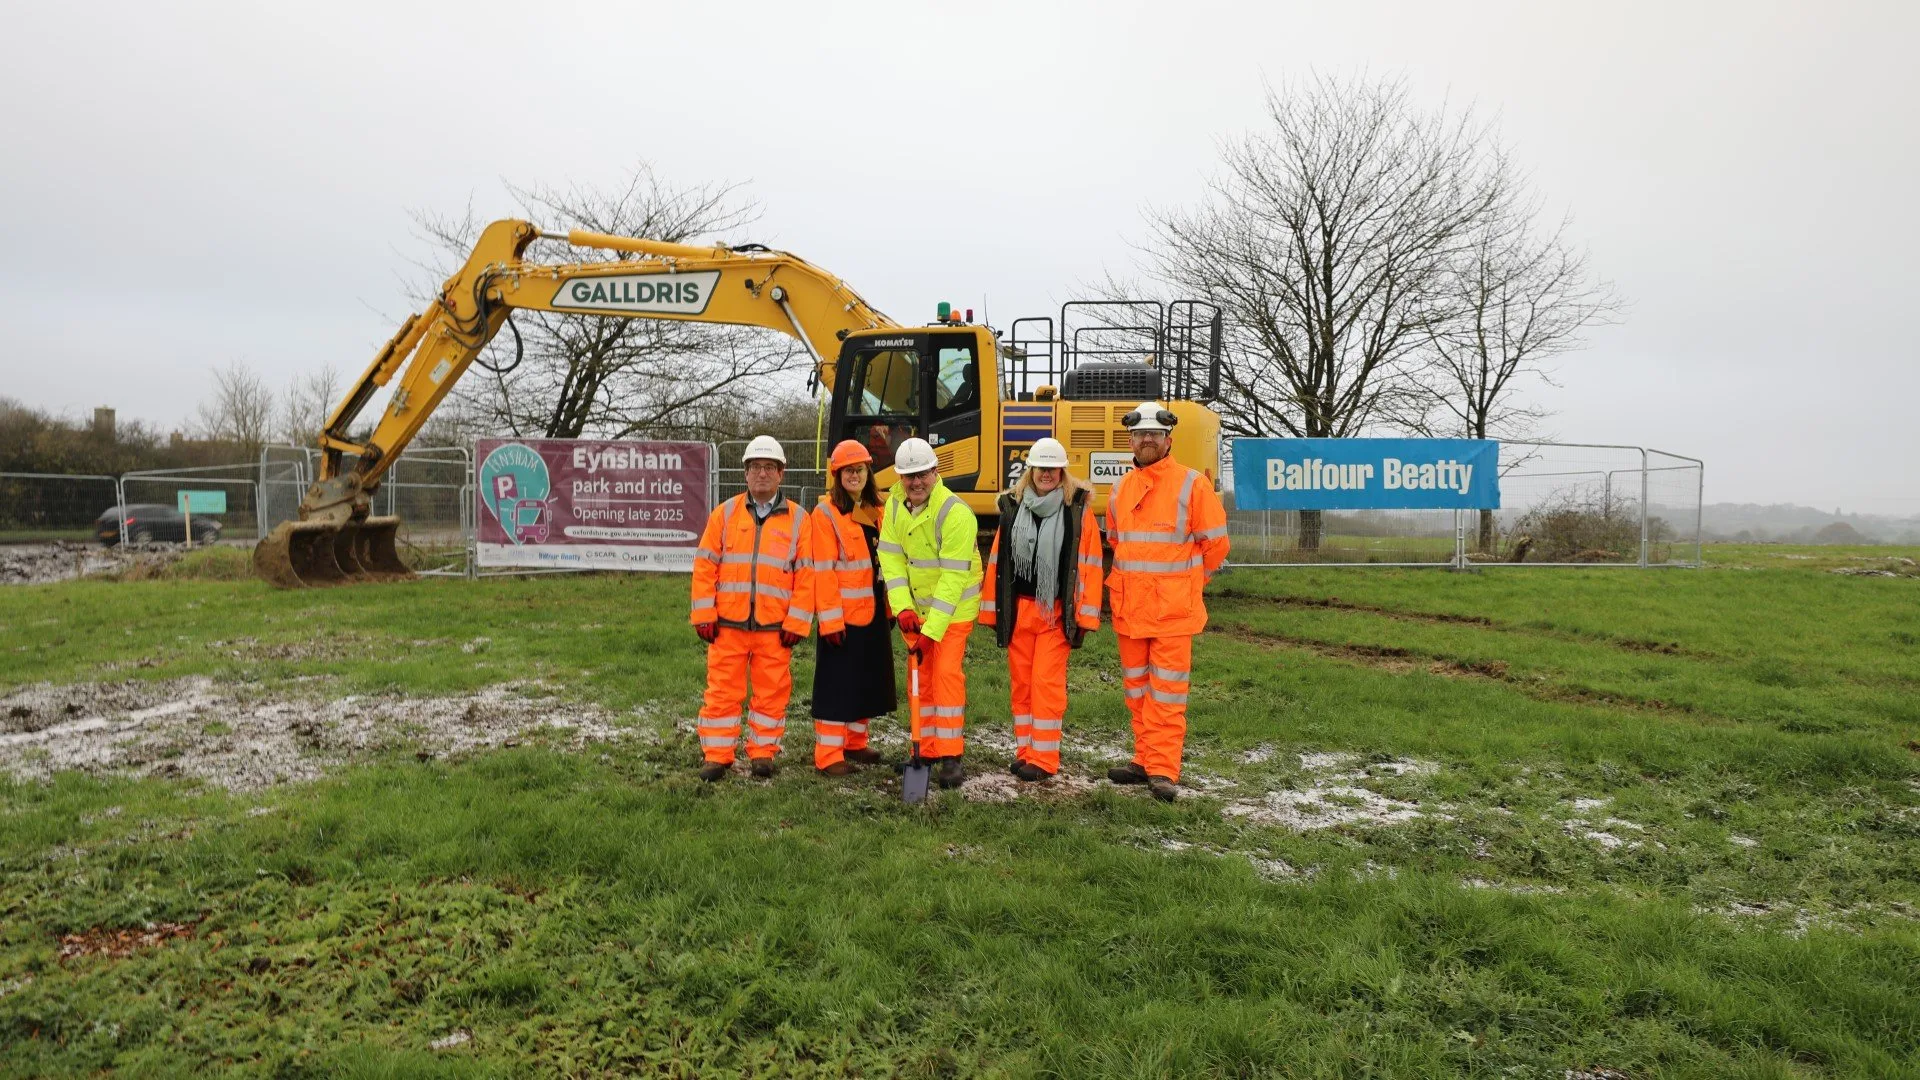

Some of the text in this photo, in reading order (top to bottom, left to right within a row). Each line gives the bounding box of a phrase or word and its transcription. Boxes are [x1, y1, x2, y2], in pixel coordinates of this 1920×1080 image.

[571, 282, 699, 304] GALLDRIS
[874, 337, 915, 347] KOMATSU
[487, 450, 539, 473] EYNSHAM
[573, 447, 682, 474] Eynsham
[497, 476, 513, 499] P
[573, 477, 683, 497] park and ride
[1266, 458, 1473, 495] Balfour Beatty
[573, 506, 684, 524] Opening late 2025
[572, 529, 688, 539] oxfordshire.gov.uk/eynshamparkride
